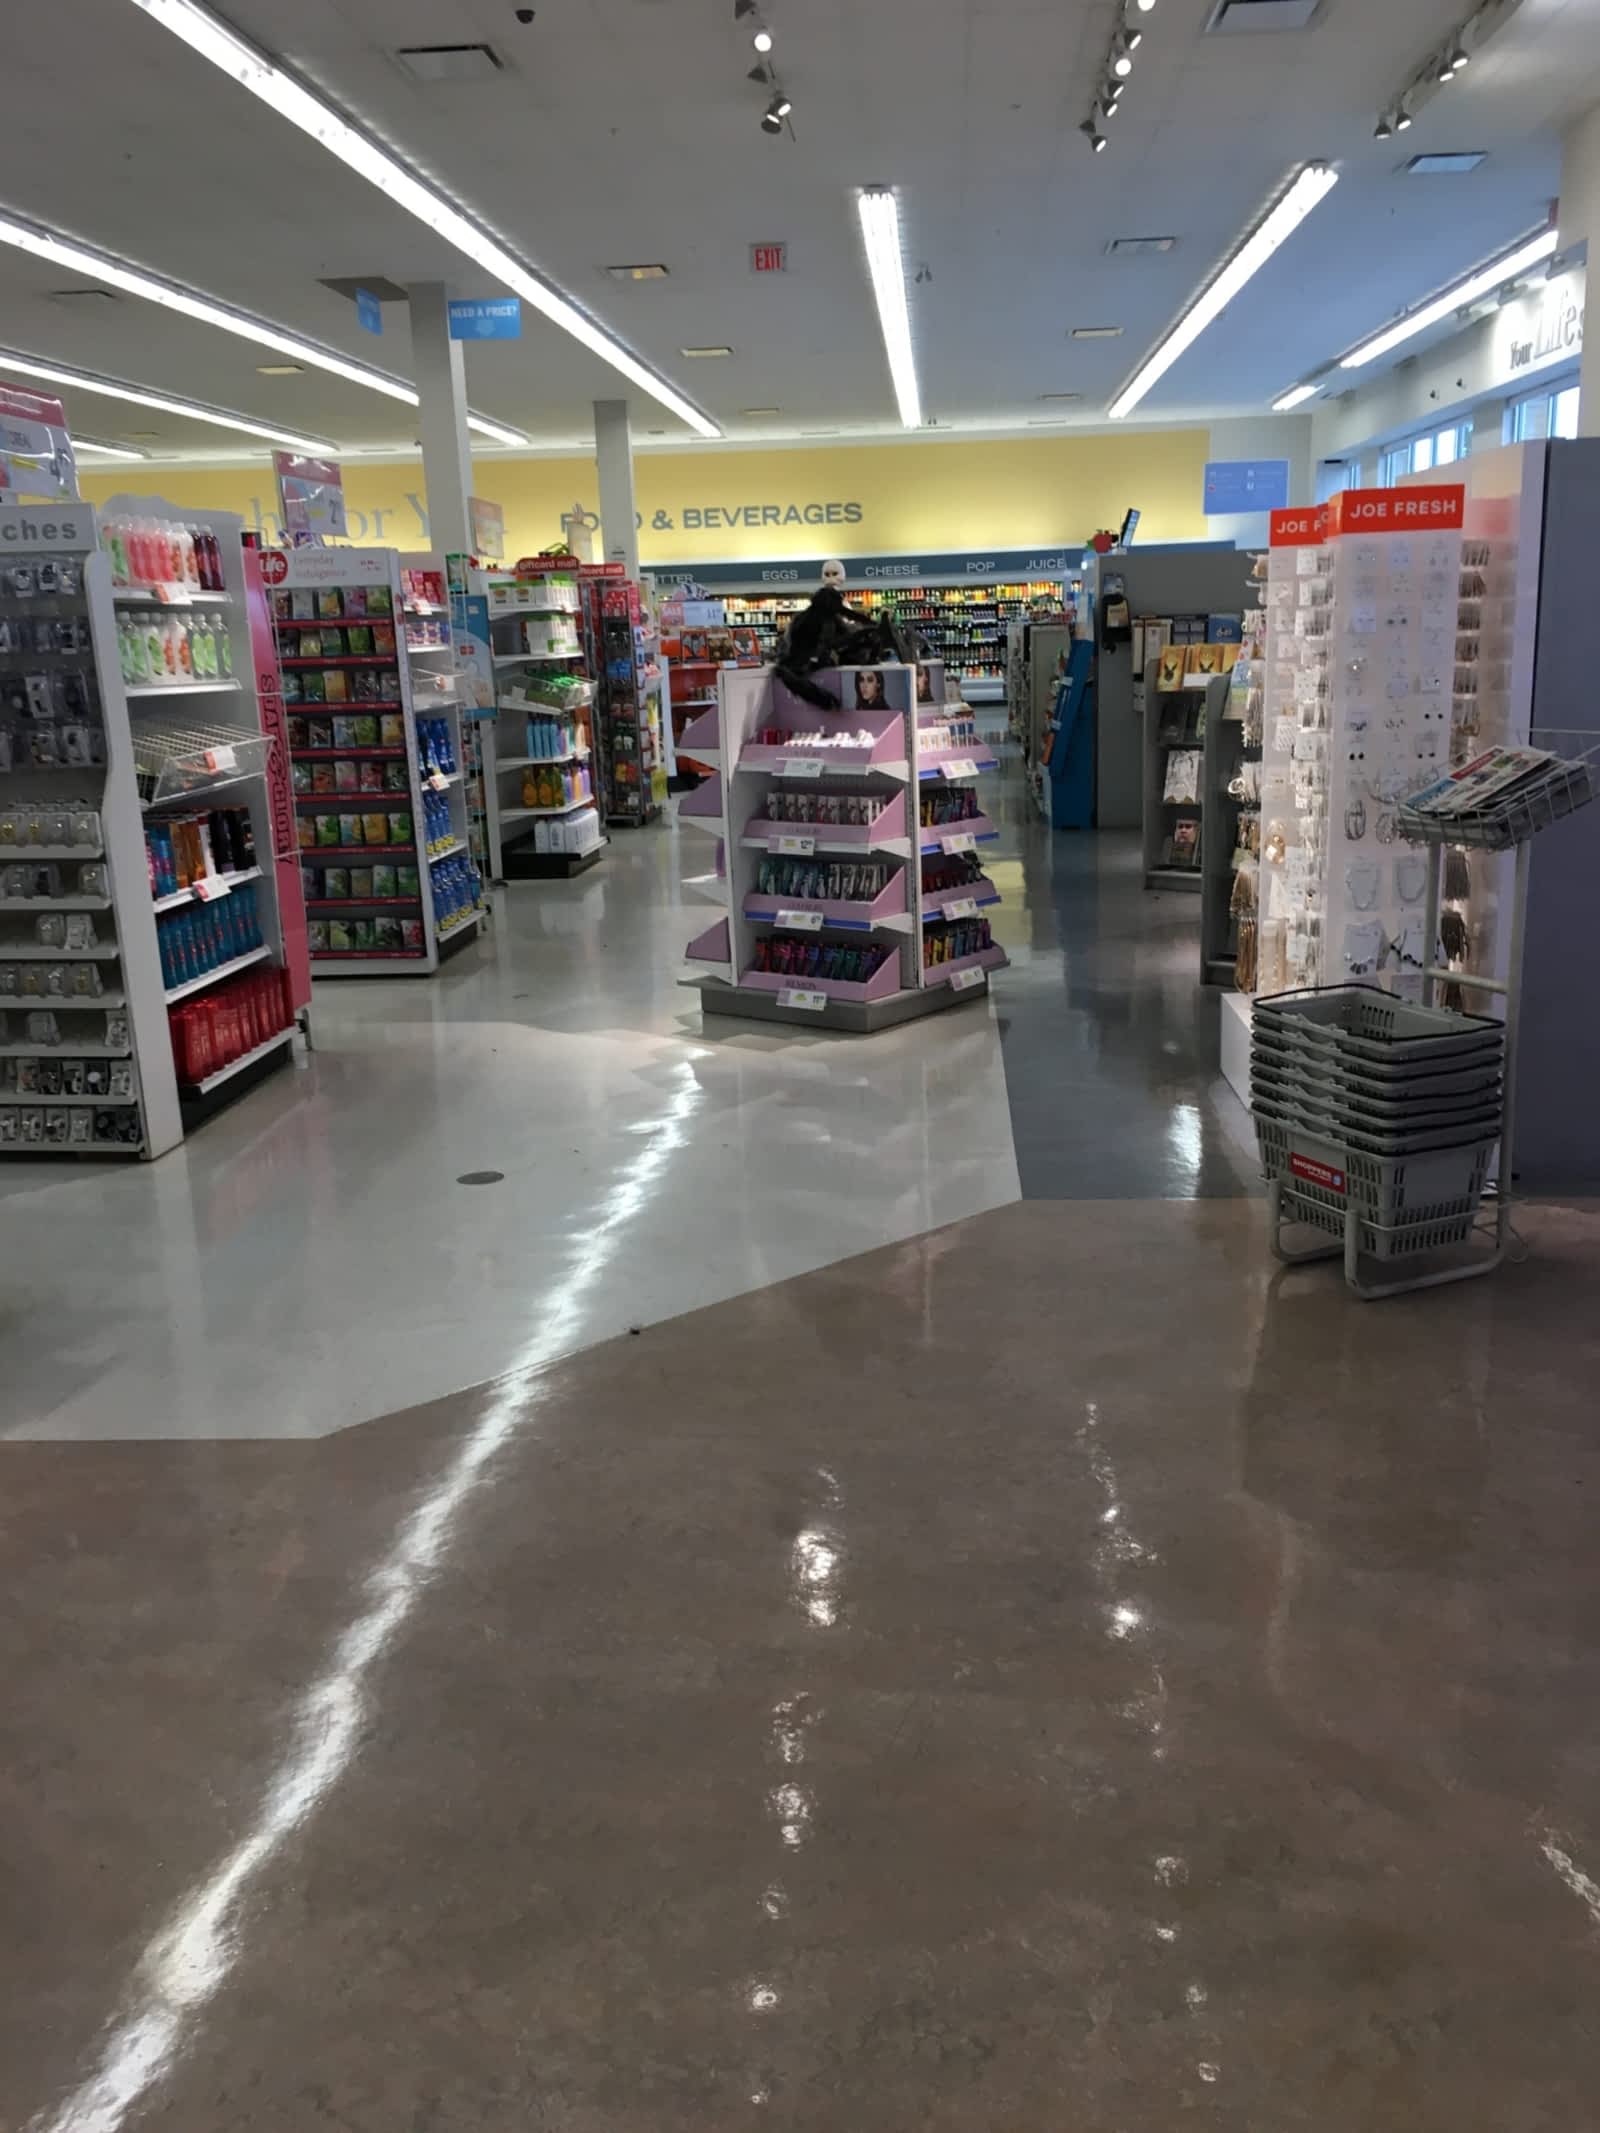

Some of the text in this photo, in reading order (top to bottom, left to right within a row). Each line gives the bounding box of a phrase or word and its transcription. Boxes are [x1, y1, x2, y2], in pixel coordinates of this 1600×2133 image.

[754, 248, 782, 271] EXIT
[1510, 341, 1533, 369] Your
[1350, 500, 1457, 518] JOE FRESH
[652, 509, 675, 530] &
[683, 503, 863, 529] BEVERAGES
[1276, 521, 1308, 534] JOE
[865, 564, 920, 577] CHEESE
[966, 561, 995, 573] POP
[1025, 558, 1065, 570] JUICE
[762, 570, 798, 581] EGGS
